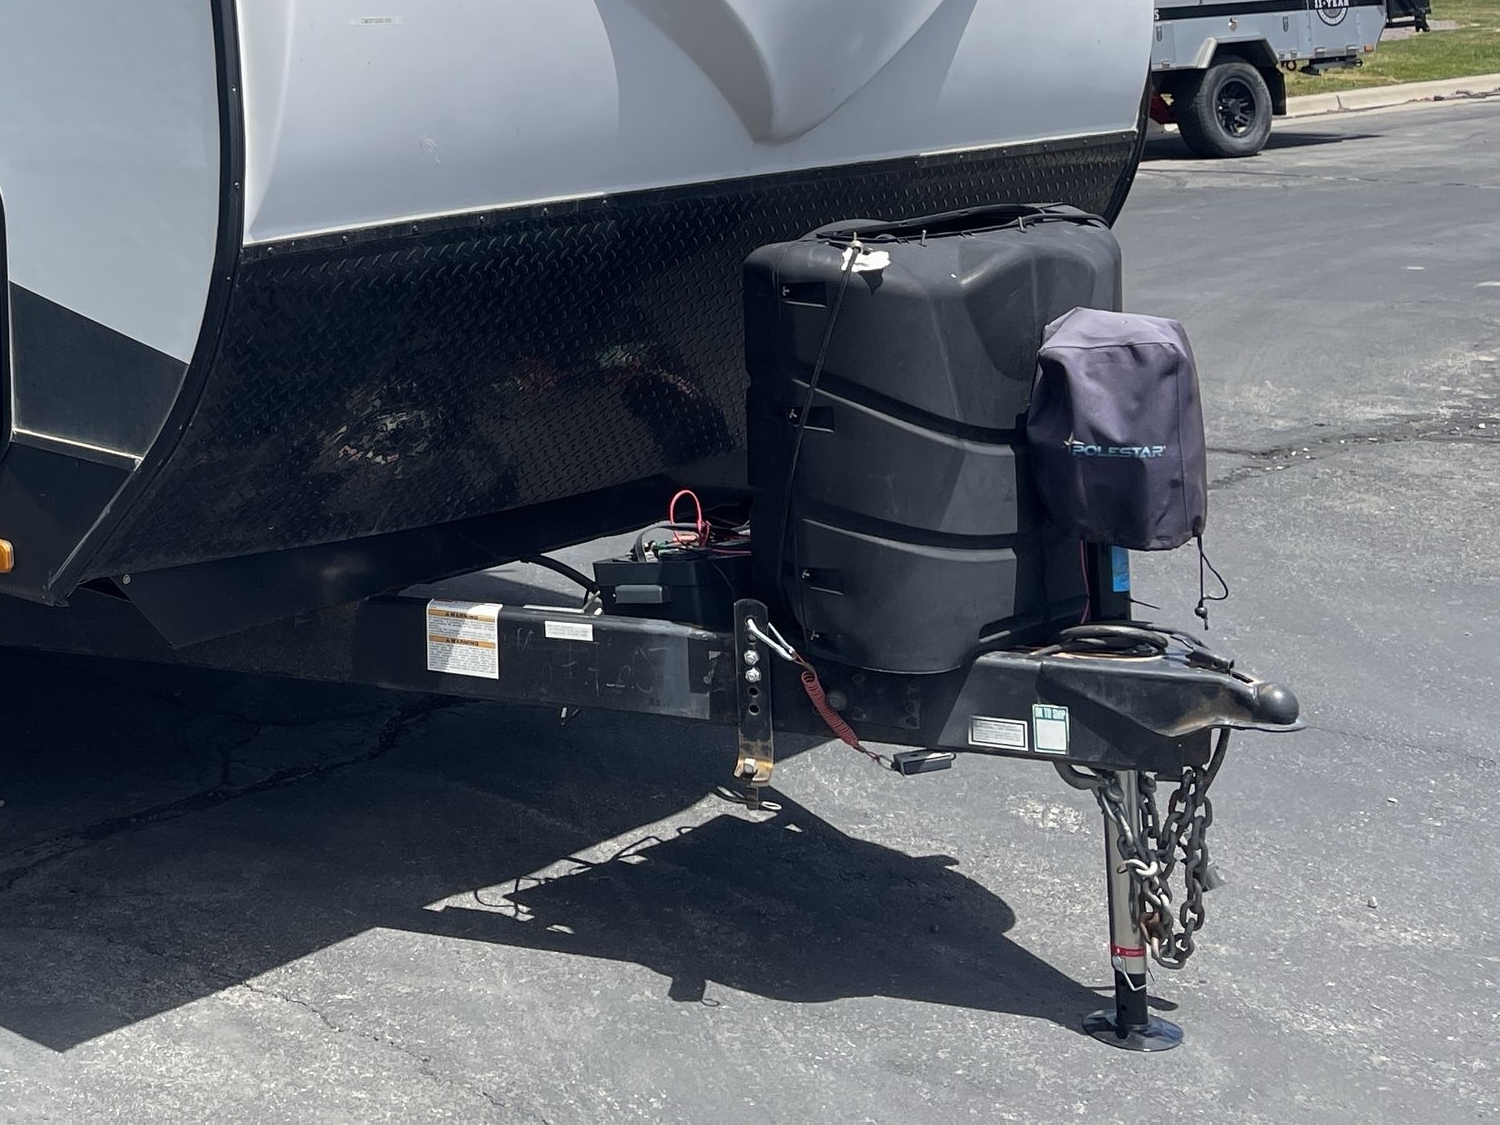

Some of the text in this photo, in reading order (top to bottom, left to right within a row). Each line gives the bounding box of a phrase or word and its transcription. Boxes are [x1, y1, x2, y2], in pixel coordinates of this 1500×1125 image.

[1071, 444, 1164, 458] POLESTAR
[450, 612, 479, 621] WARNING
[450, 638, 480, 647] WARNING
